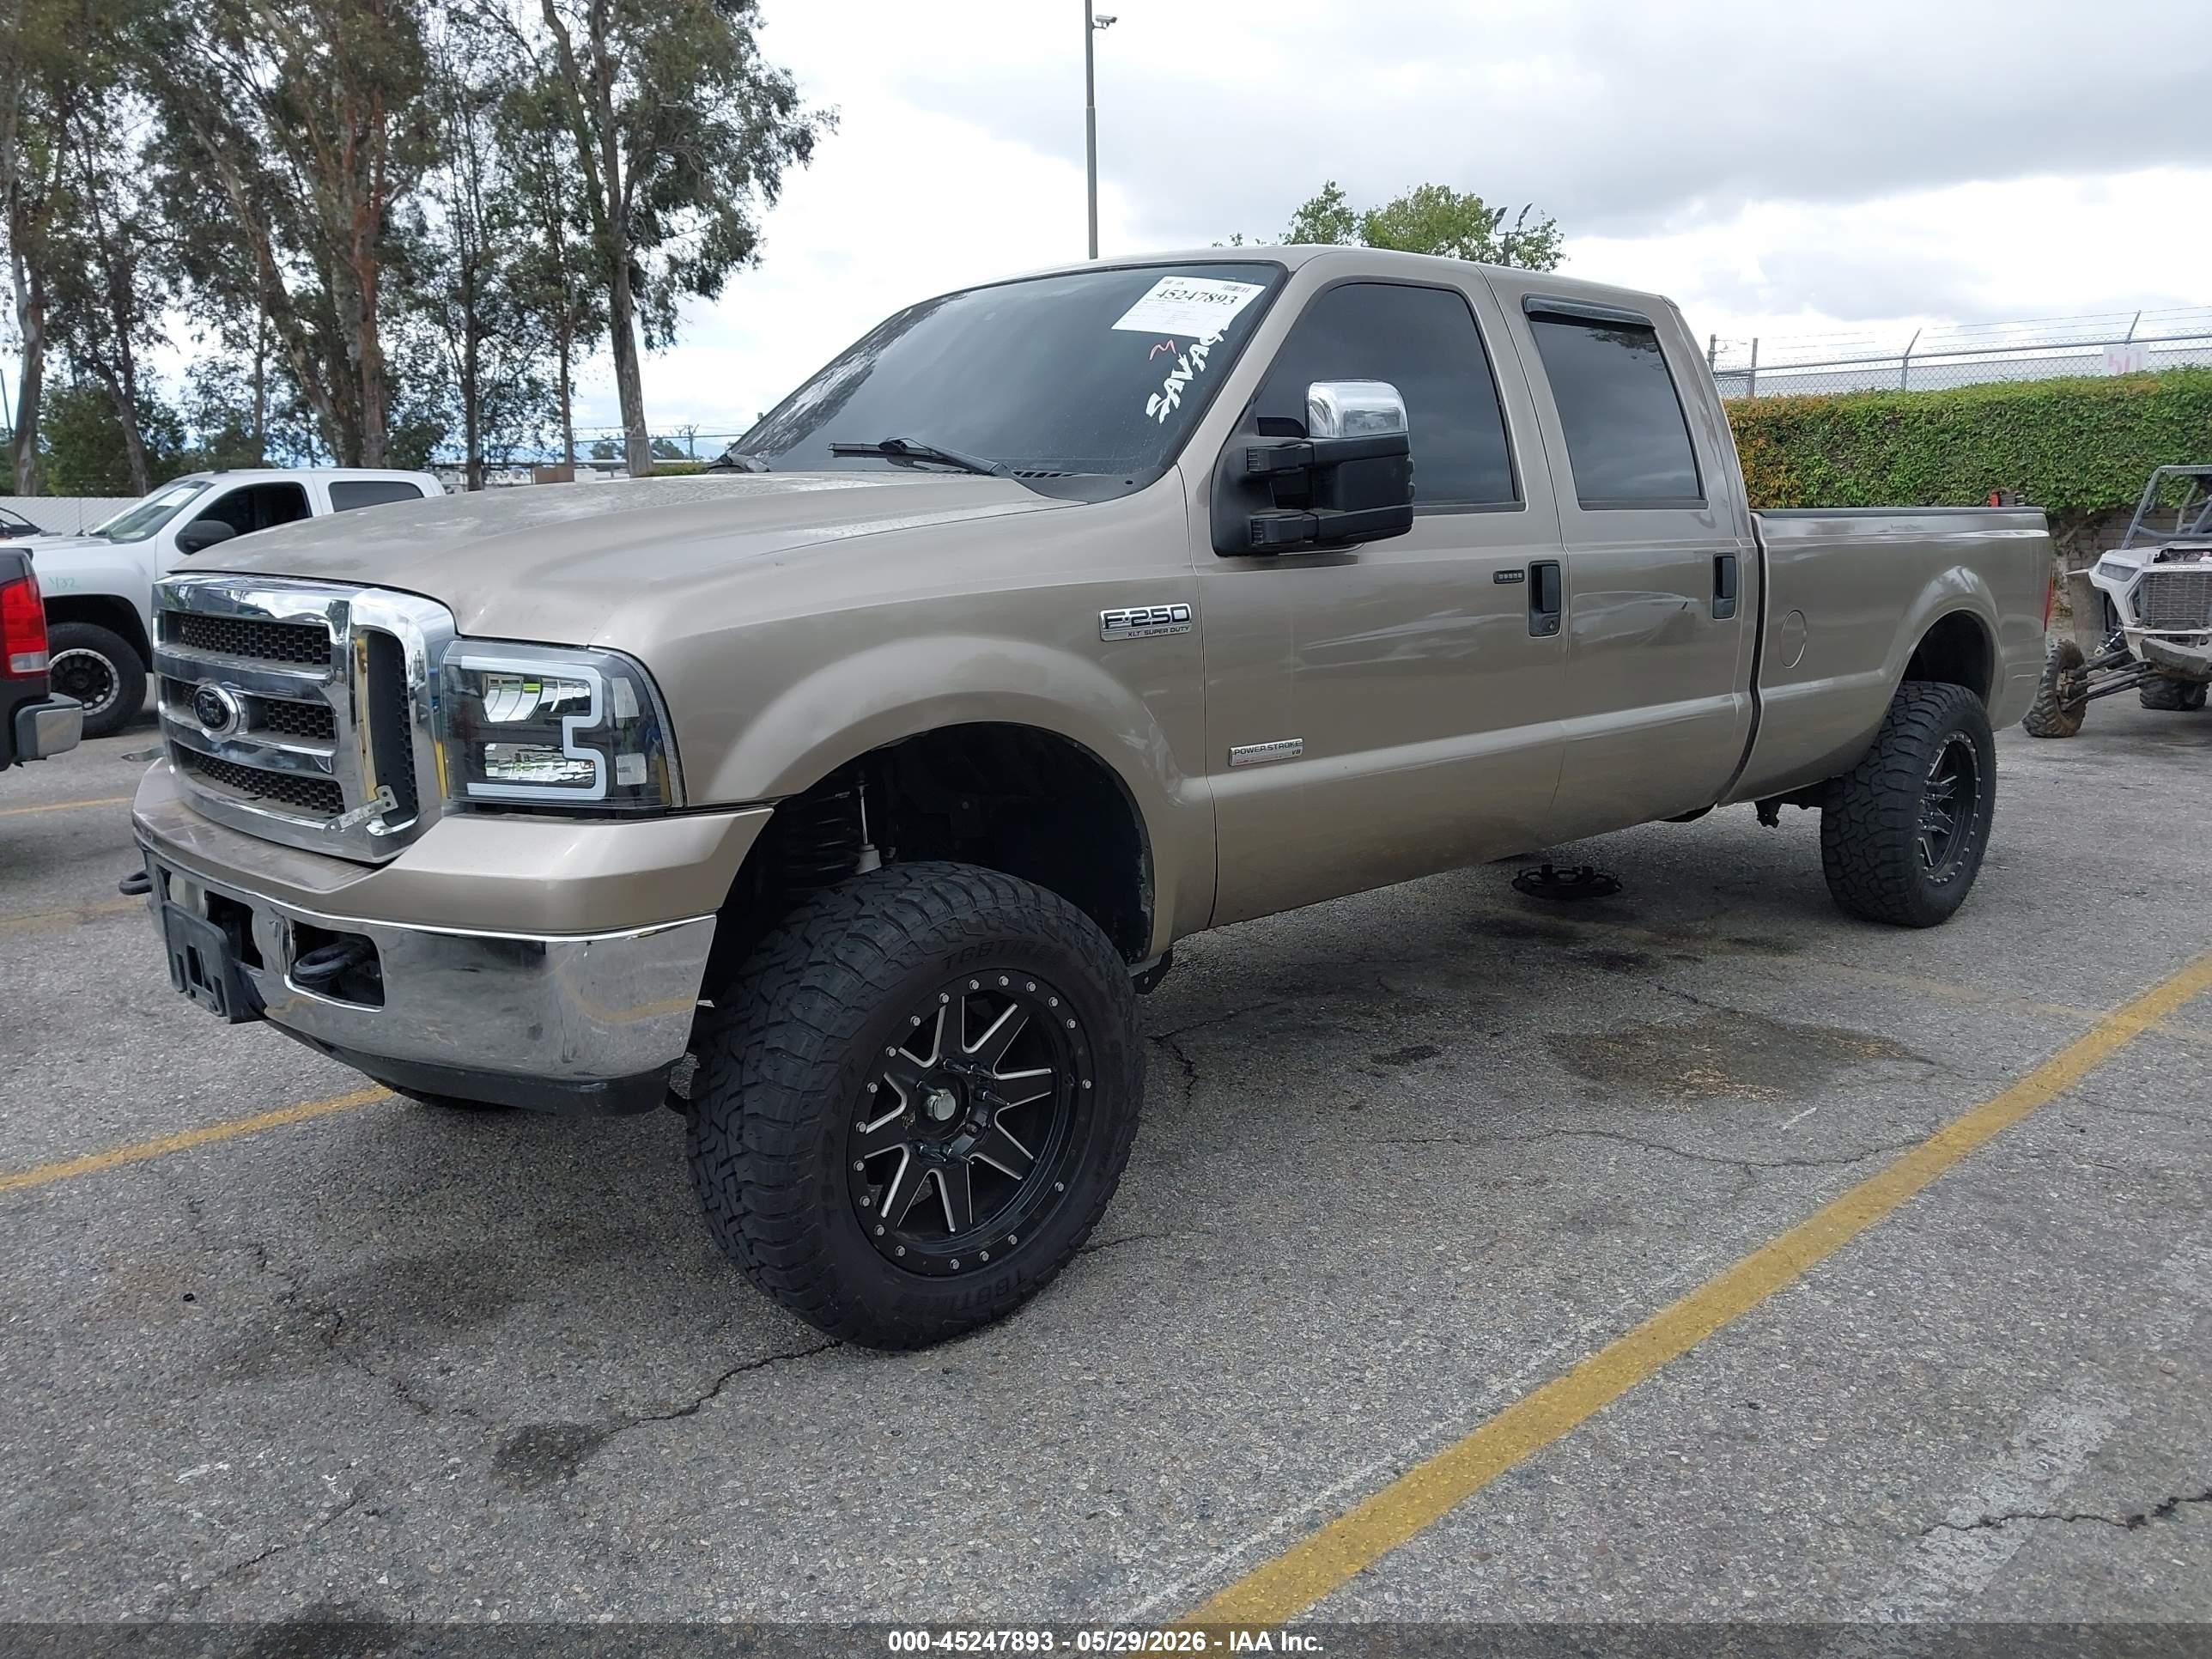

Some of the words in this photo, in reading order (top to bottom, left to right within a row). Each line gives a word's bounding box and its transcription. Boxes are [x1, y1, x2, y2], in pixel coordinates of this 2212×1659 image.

[1157, 289, 1238, 306] 45247893
[1103, 605, 1190, 629] F-250
[1144, 628, 1169, 636] SUPER
